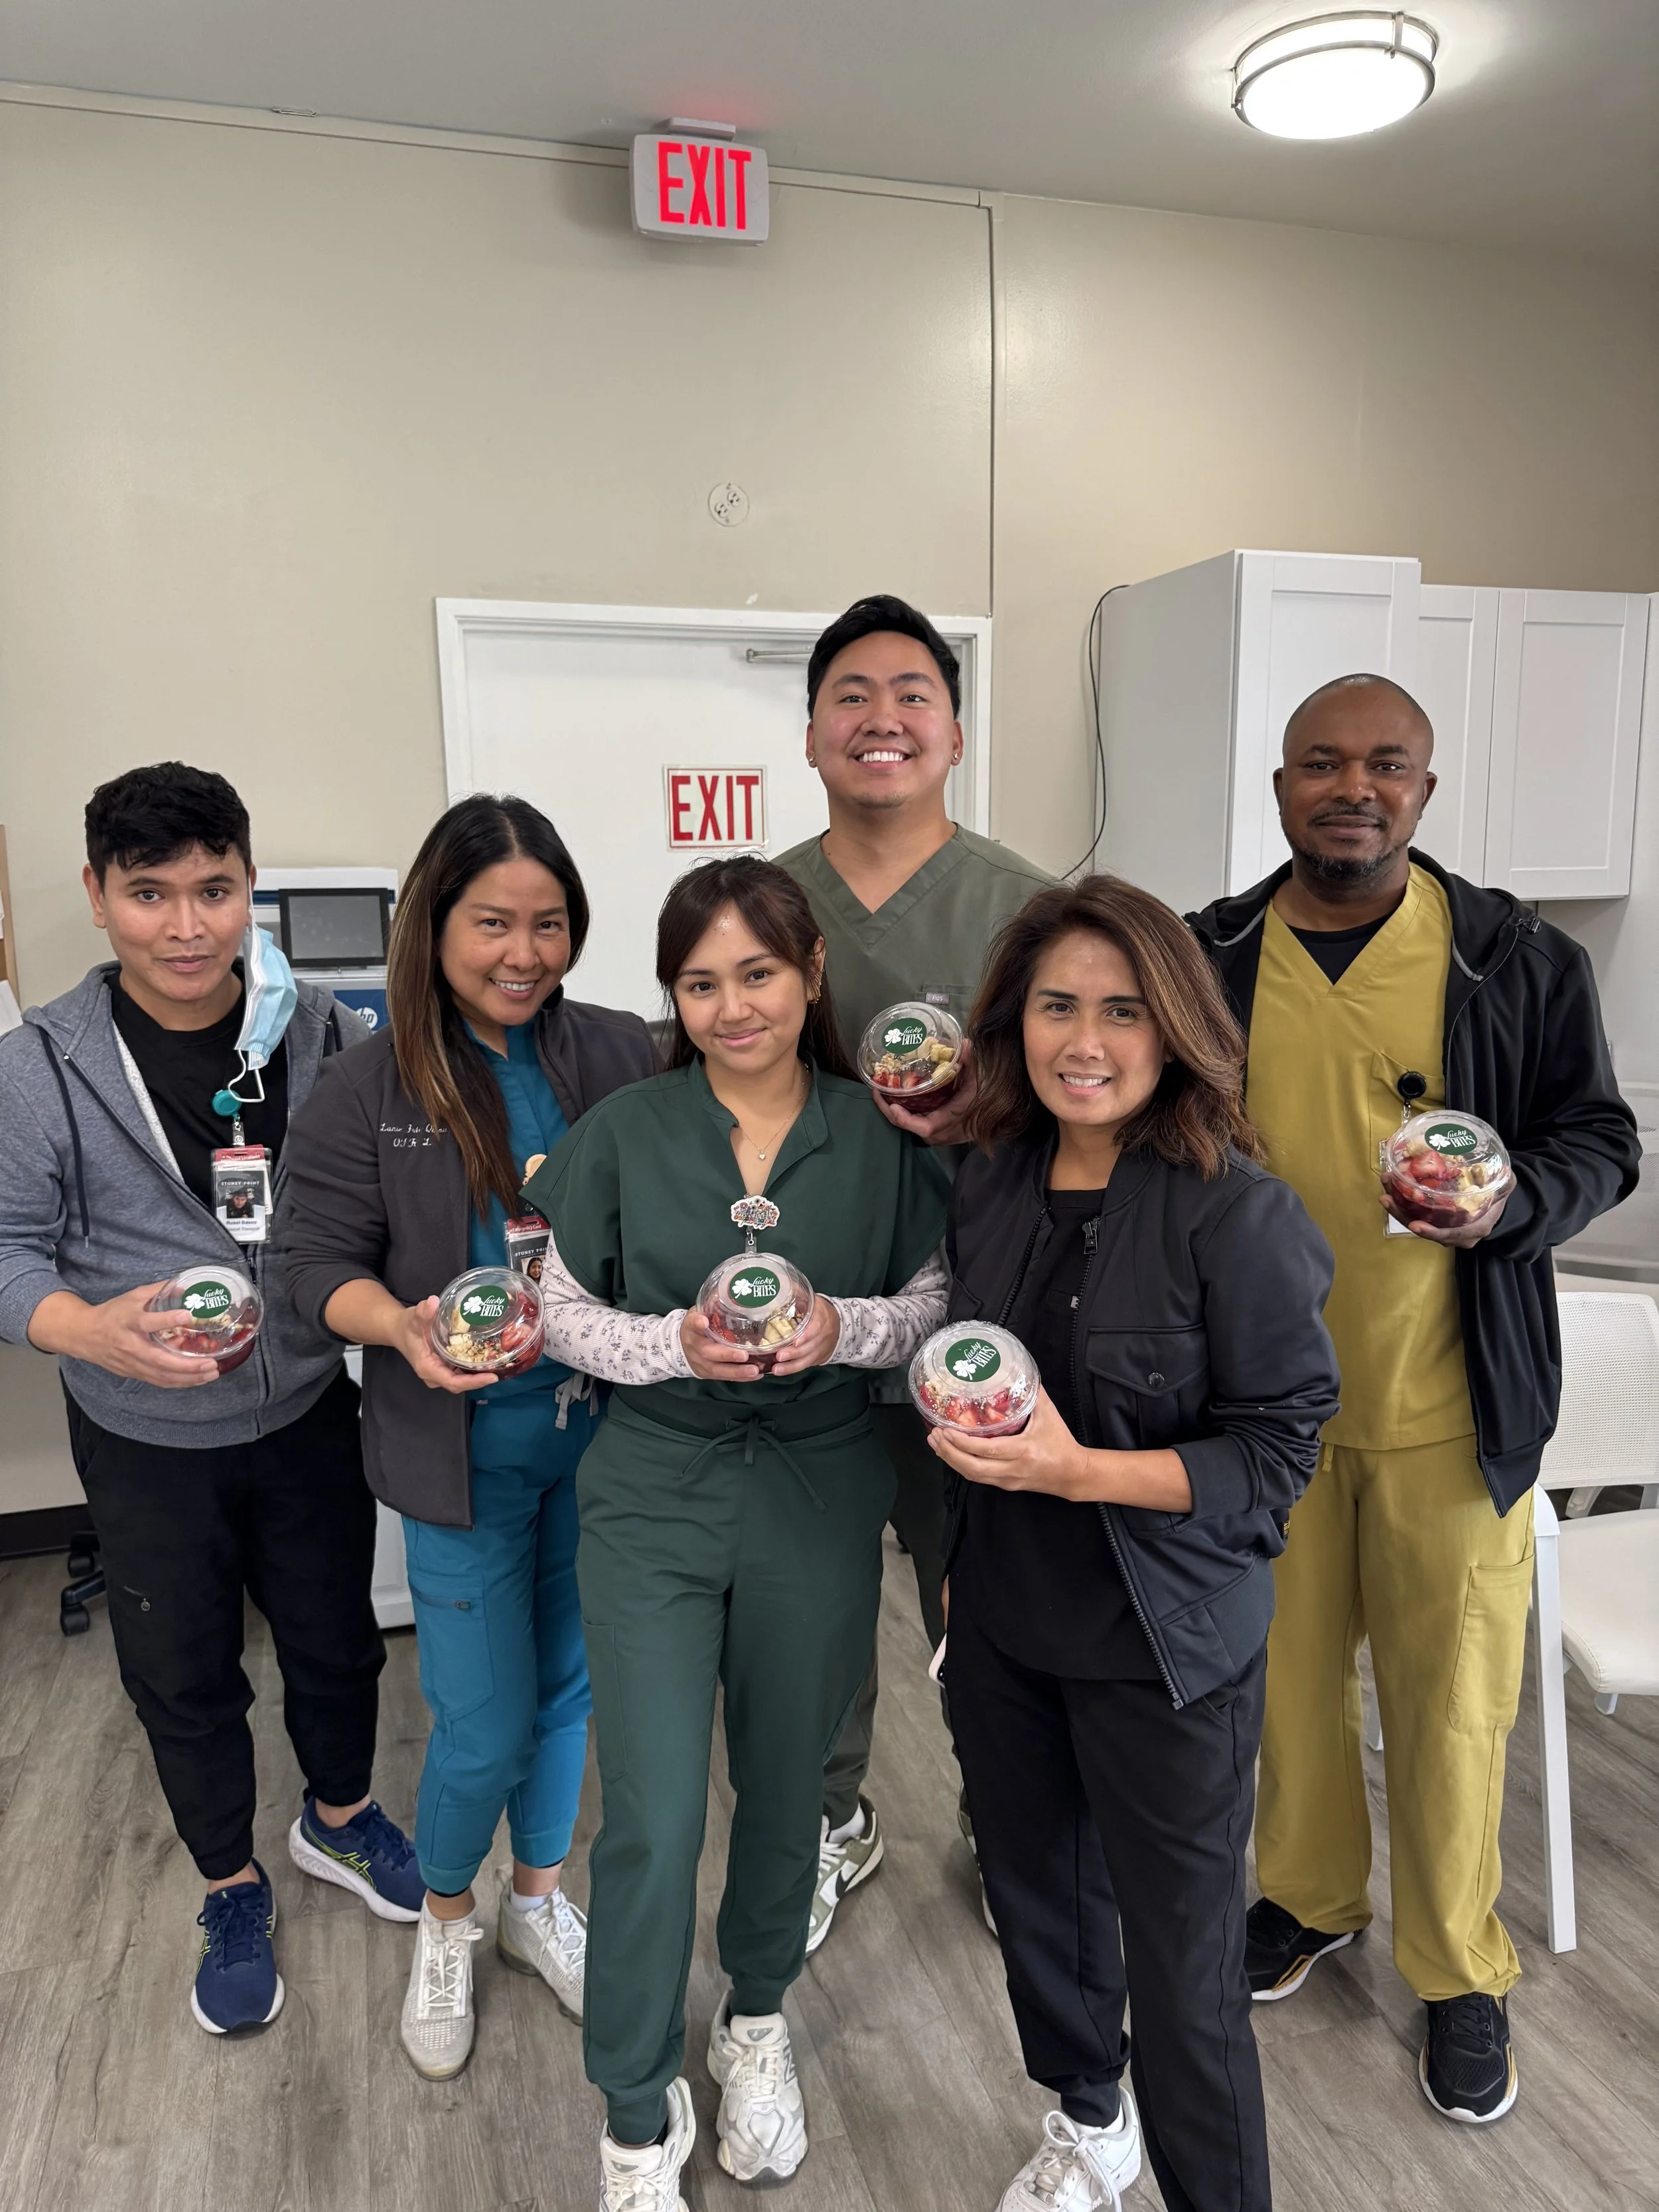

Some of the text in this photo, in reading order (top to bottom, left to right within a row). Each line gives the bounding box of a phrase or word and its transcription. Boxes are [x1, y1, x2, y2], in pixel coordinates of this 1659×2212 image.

[658, 141, 752, 230] EXIT
[671, 775, 759, 841] EXIT
[901, 1026, 922, 1036] Lucky
[902, 1033, 923, 1045] BITES
[1446, 1129, 1467, 1140] Lucky
[1450, 1135, 1477, 1148] BITES
[751, 1276, 774, 1287] Lucky
[202, 1288, 224, 1300] Lucky
[753, 1284, 776, 1297] BITES
[205, 1294, 230, 1309] BITES
[481, 1295, 505, 1306] Lucky
[480, 1304, 504, 1317] BITES
[964, 1342, 982, 1363] Lucky
[972, 1345, 997, 1367] BITES
